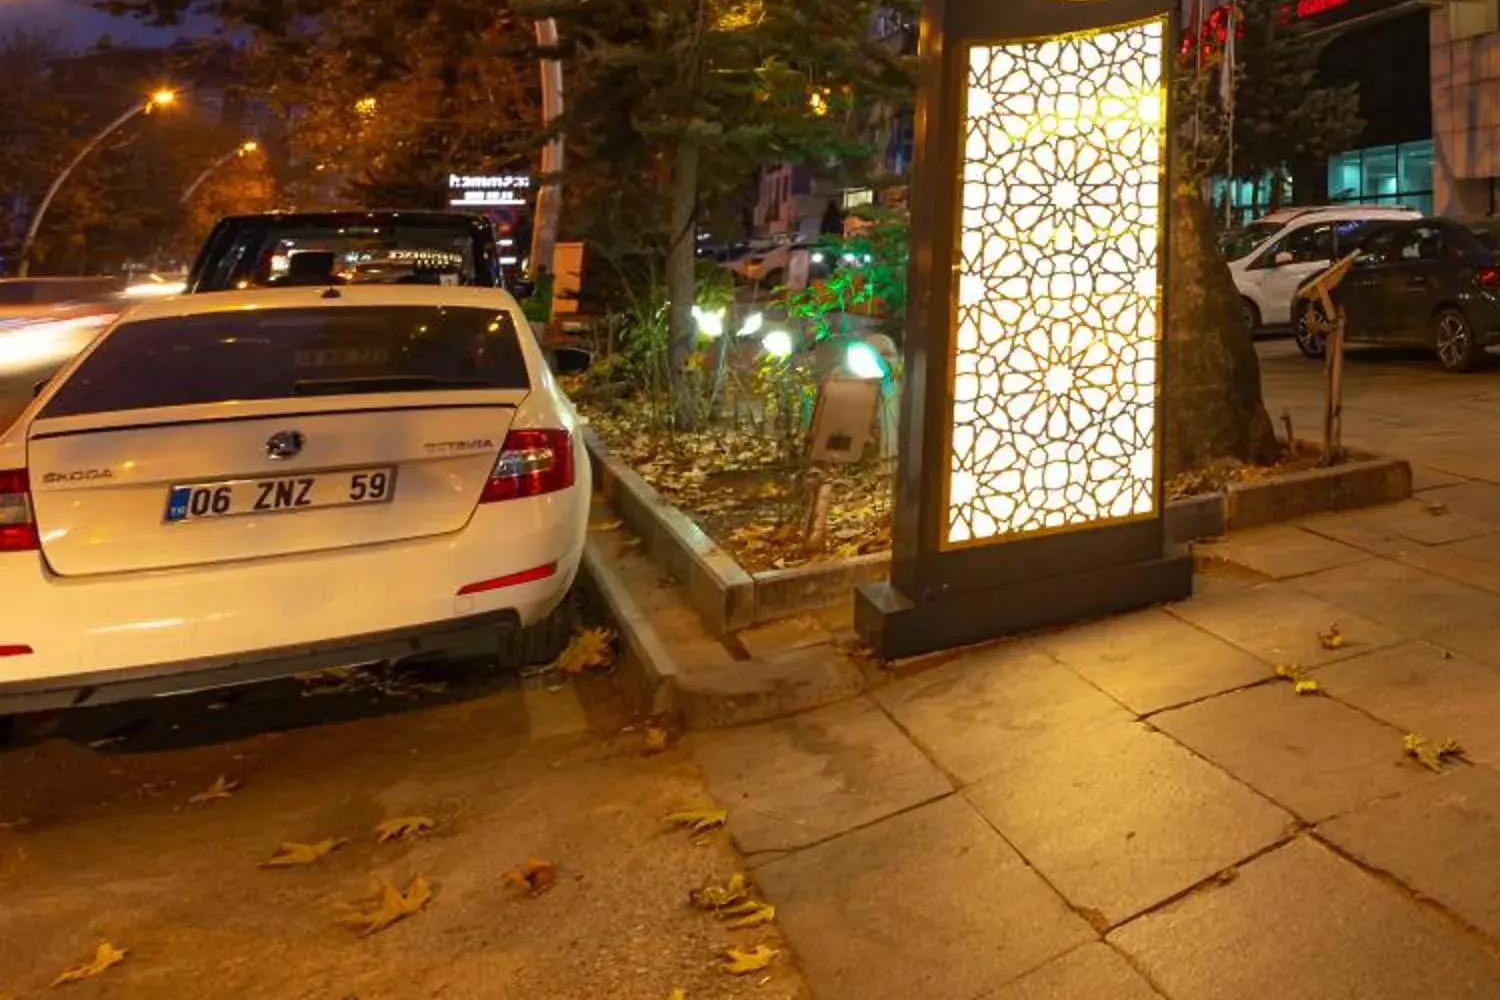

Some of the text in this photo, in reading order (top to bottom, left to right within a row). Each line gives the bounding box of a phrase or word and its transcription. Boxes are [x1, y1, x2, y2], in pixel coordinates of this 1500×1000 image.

[190, 472, 387, 515] 06 ZNZ 59
